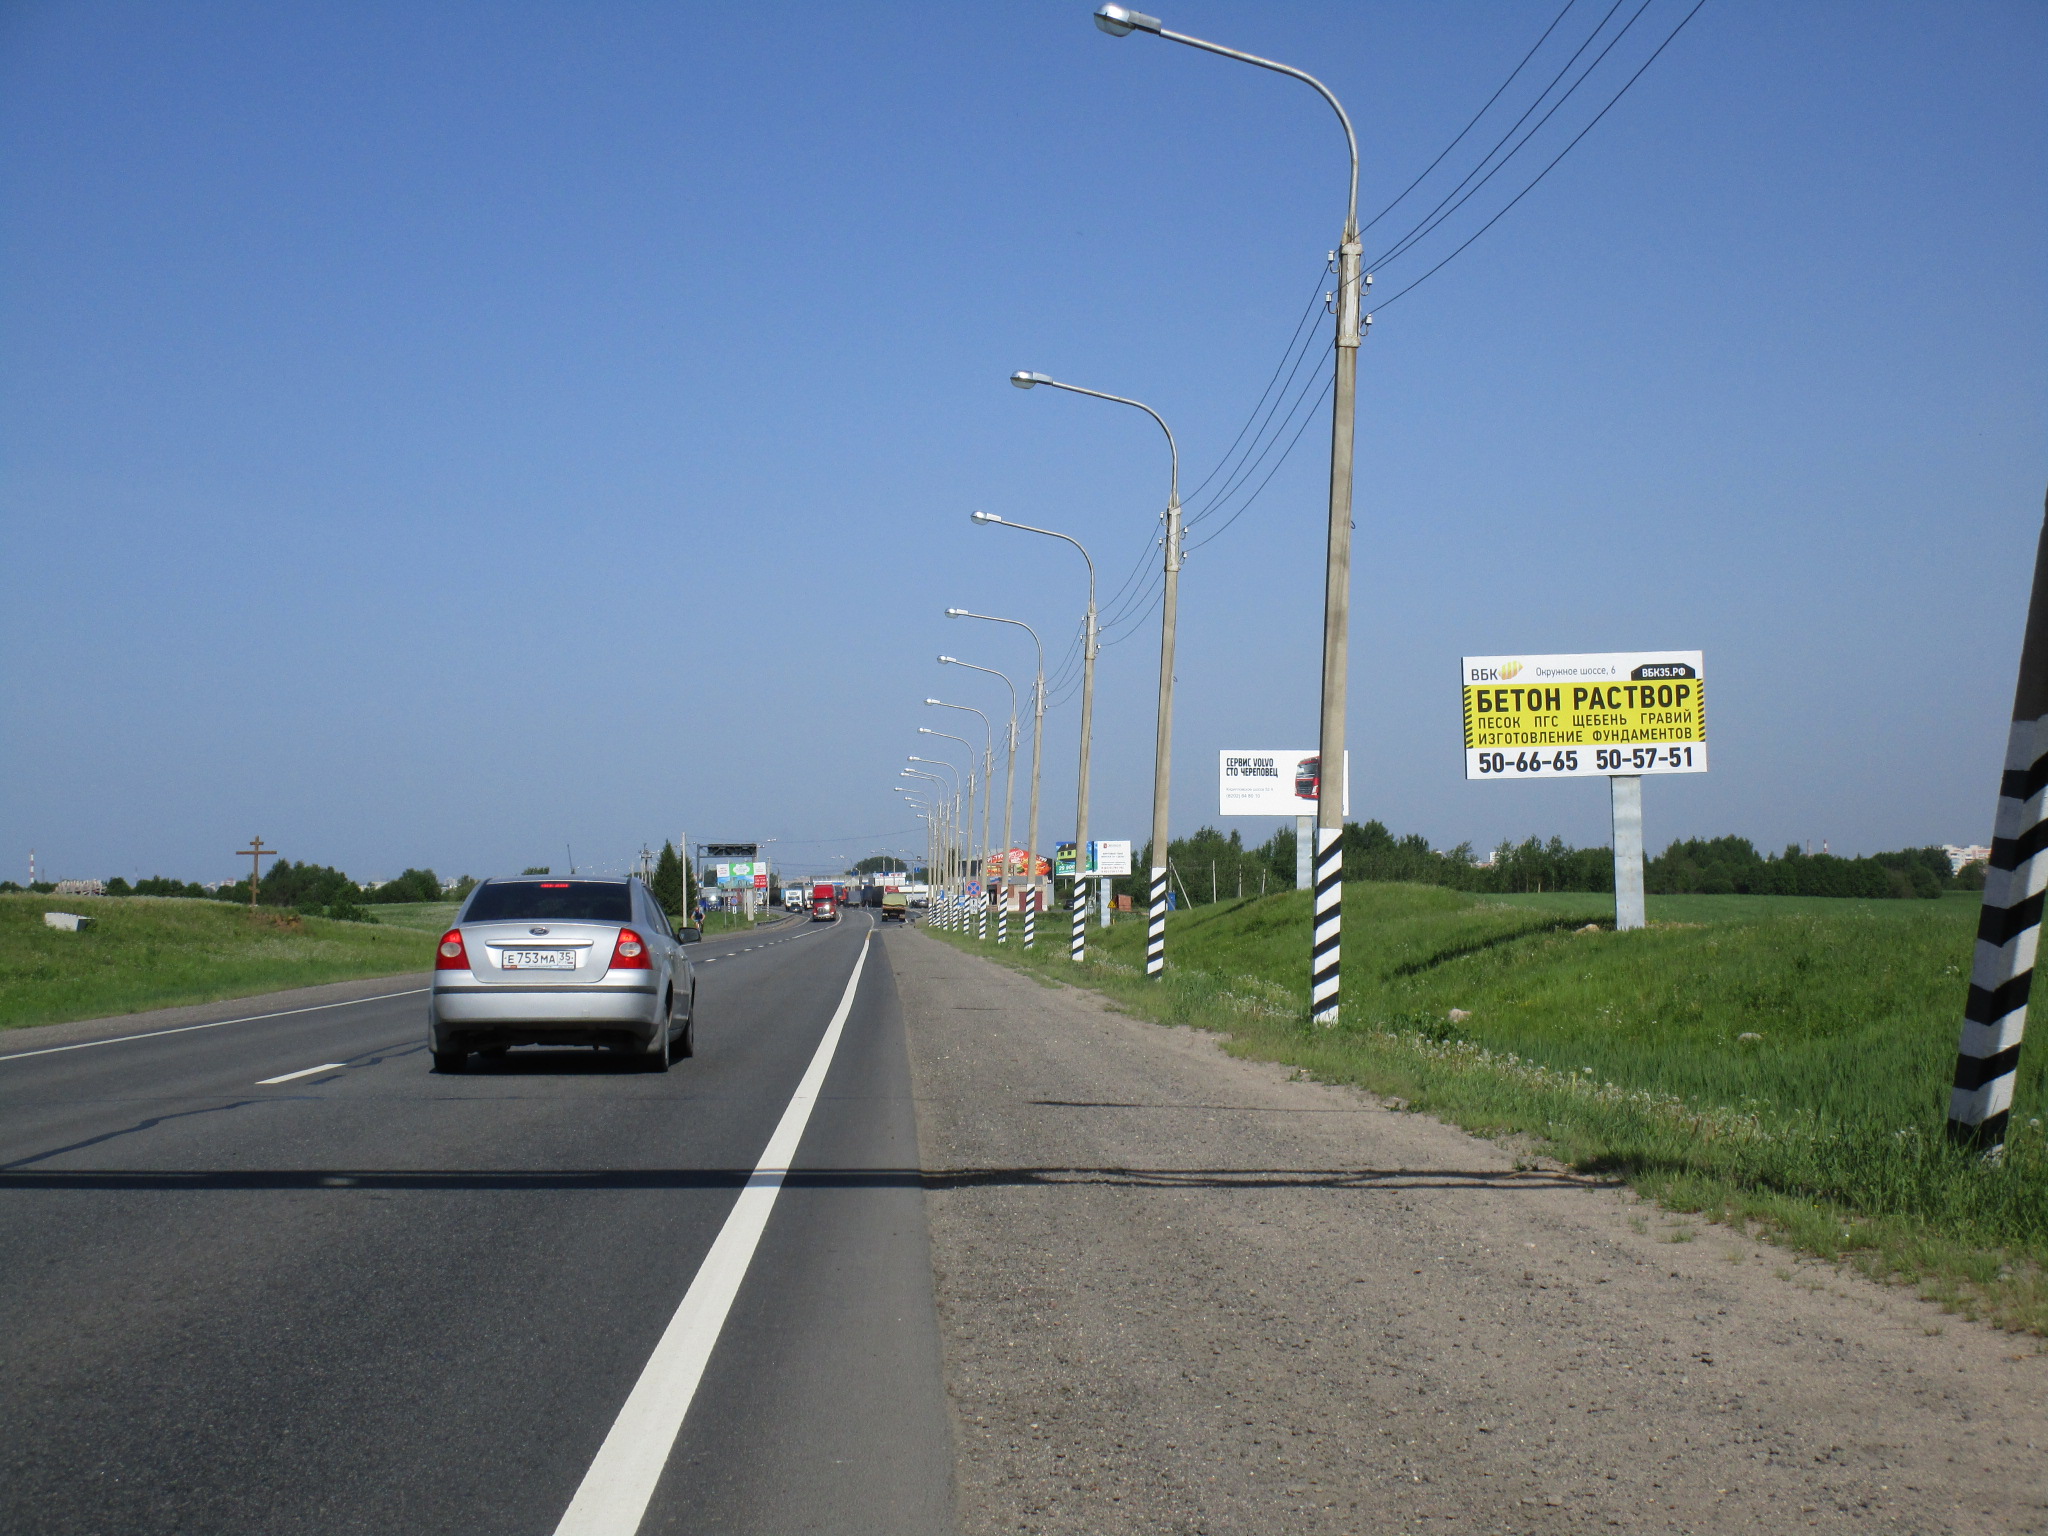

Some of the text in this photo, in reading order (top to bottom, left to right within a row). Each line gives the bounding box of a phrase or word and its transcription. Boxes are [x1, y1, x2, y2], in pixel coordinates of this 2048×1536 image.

[1471, 668, 1498, 681] ВБК
[1535, 665, 1616, 678] Окружное шоссе, 6
[1642, 666, 1686, 678] ВБК35.РФ
[1477, 684, 1690, 713] БЕТОН РАСТВОР
[1478, 709, 1692, 729] ПЕСОК ПГС ЩЕБЕНЬ ГРАВИЙ
[1478, 727, 1692, 745] ИЗГОТОВЛЕНИЕ ФУНДАМЕНТОВ
[1226, 758, 1274, 767] СЕРВИС VOLVO
[1479, 747, 1692, 773] 50-66-65 50-57-51
[1226, 767, 1278, 778] СТО ЧЕРЕПОВЕЦ
[559, 952, 571, 961] 35
